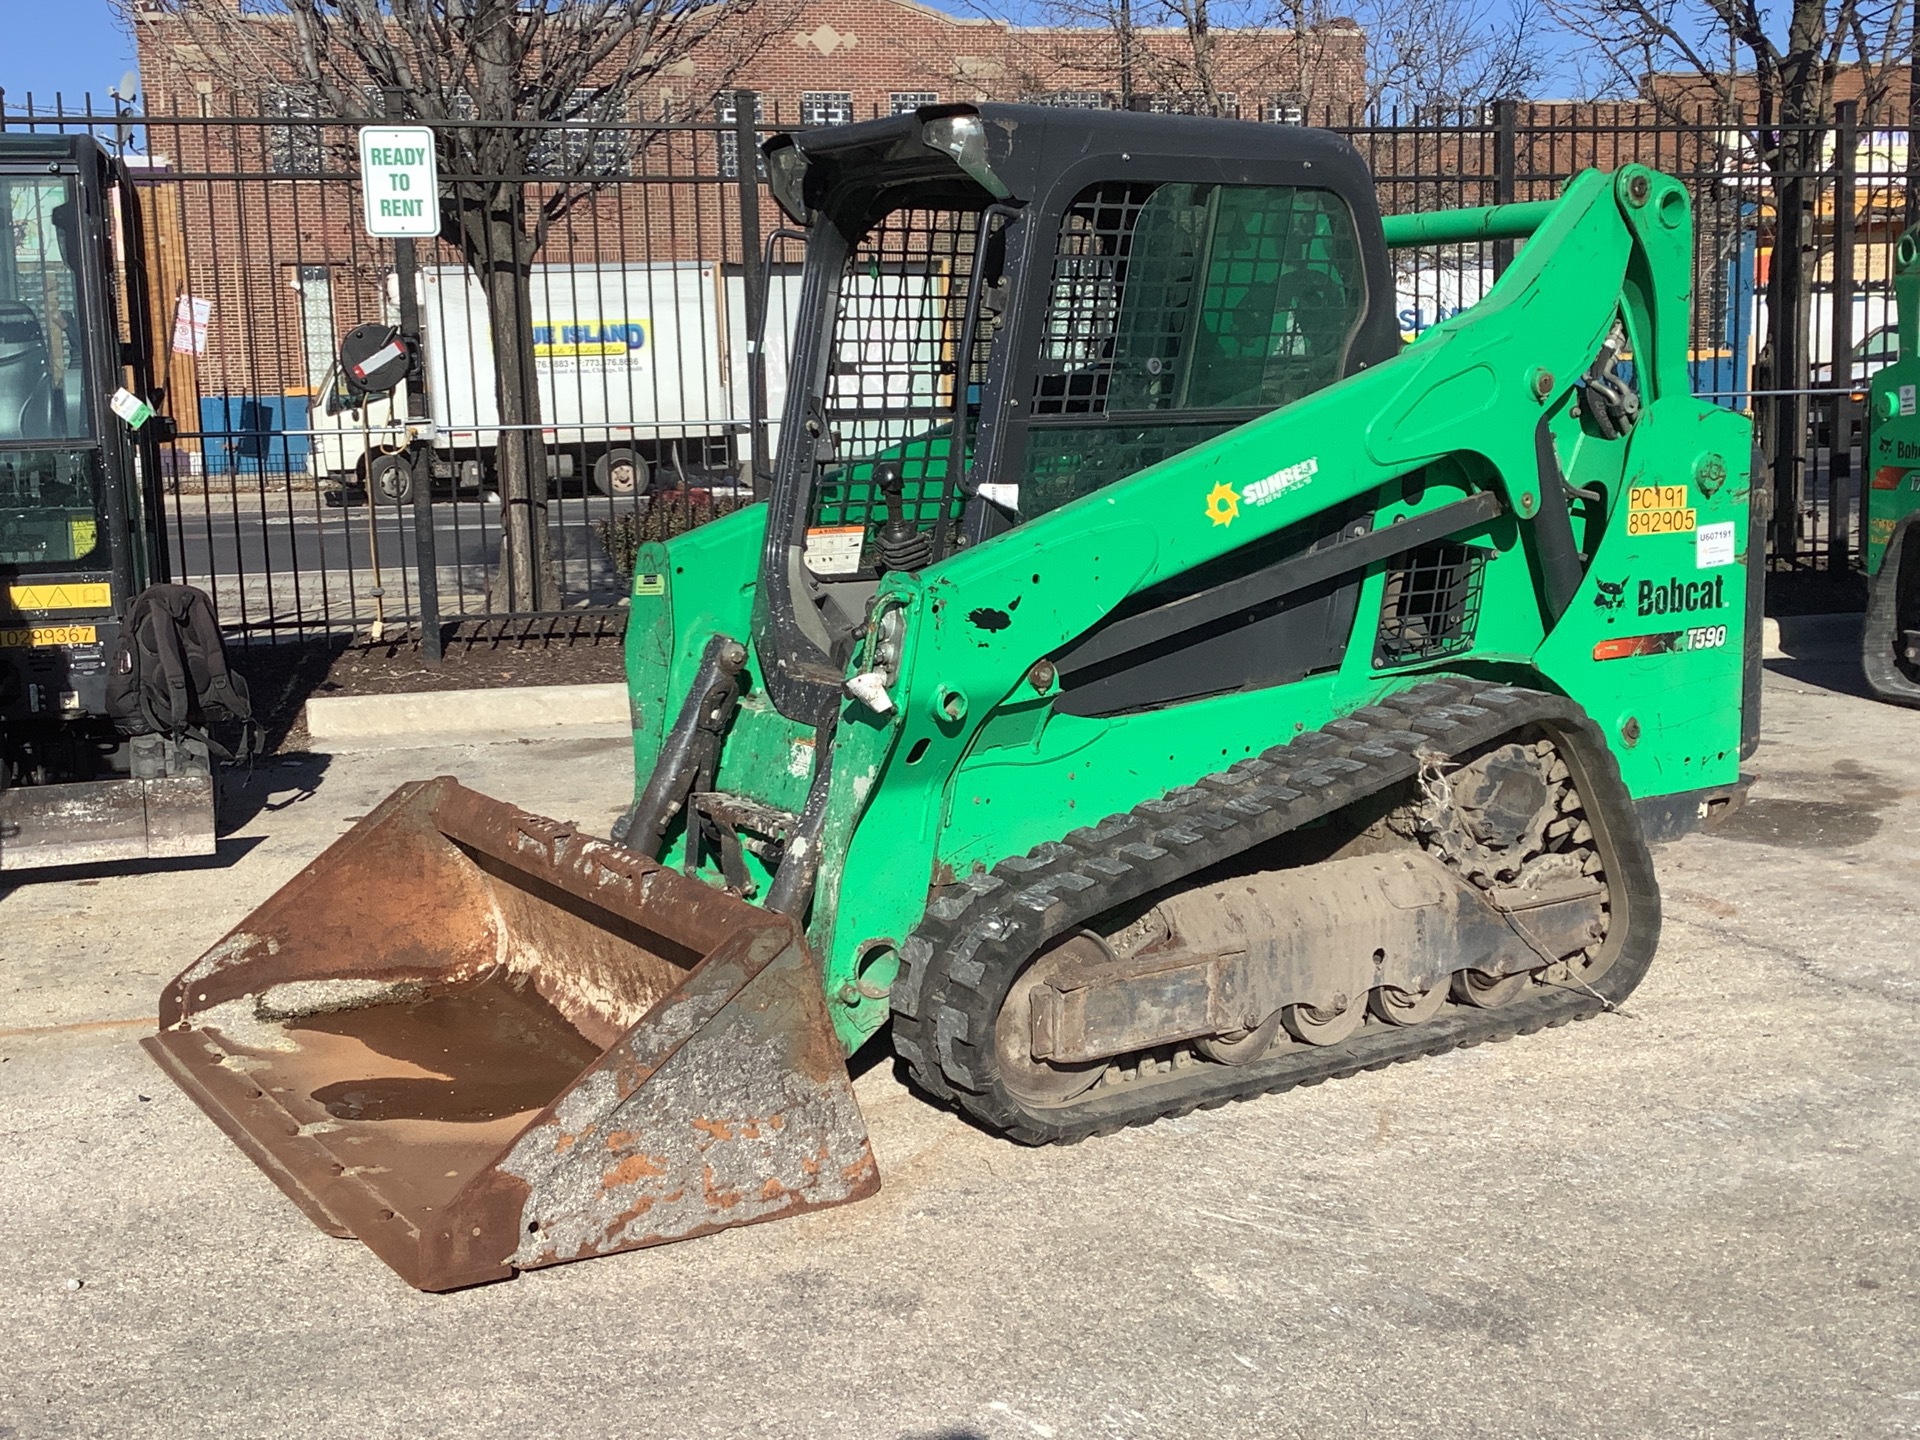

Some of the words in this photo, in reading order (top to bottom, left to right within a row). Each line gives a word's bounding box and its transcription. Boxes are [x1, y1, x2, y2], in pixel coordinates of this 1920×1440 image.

[370, 147, 426, 166] READY
[388, 173, 411, 192] TO
[379, 198, 424, 217] RENT
[561, 322, 646, 350] ISLAND
[1630, 486, 1684, 510] PC191
[1628, 509, 1696, 535] 892905
[1699, 529, 1732, 542] U607191
[1637, 574, 1724, 617] Bobcat
[1687, 623, 1728, 651] T590
